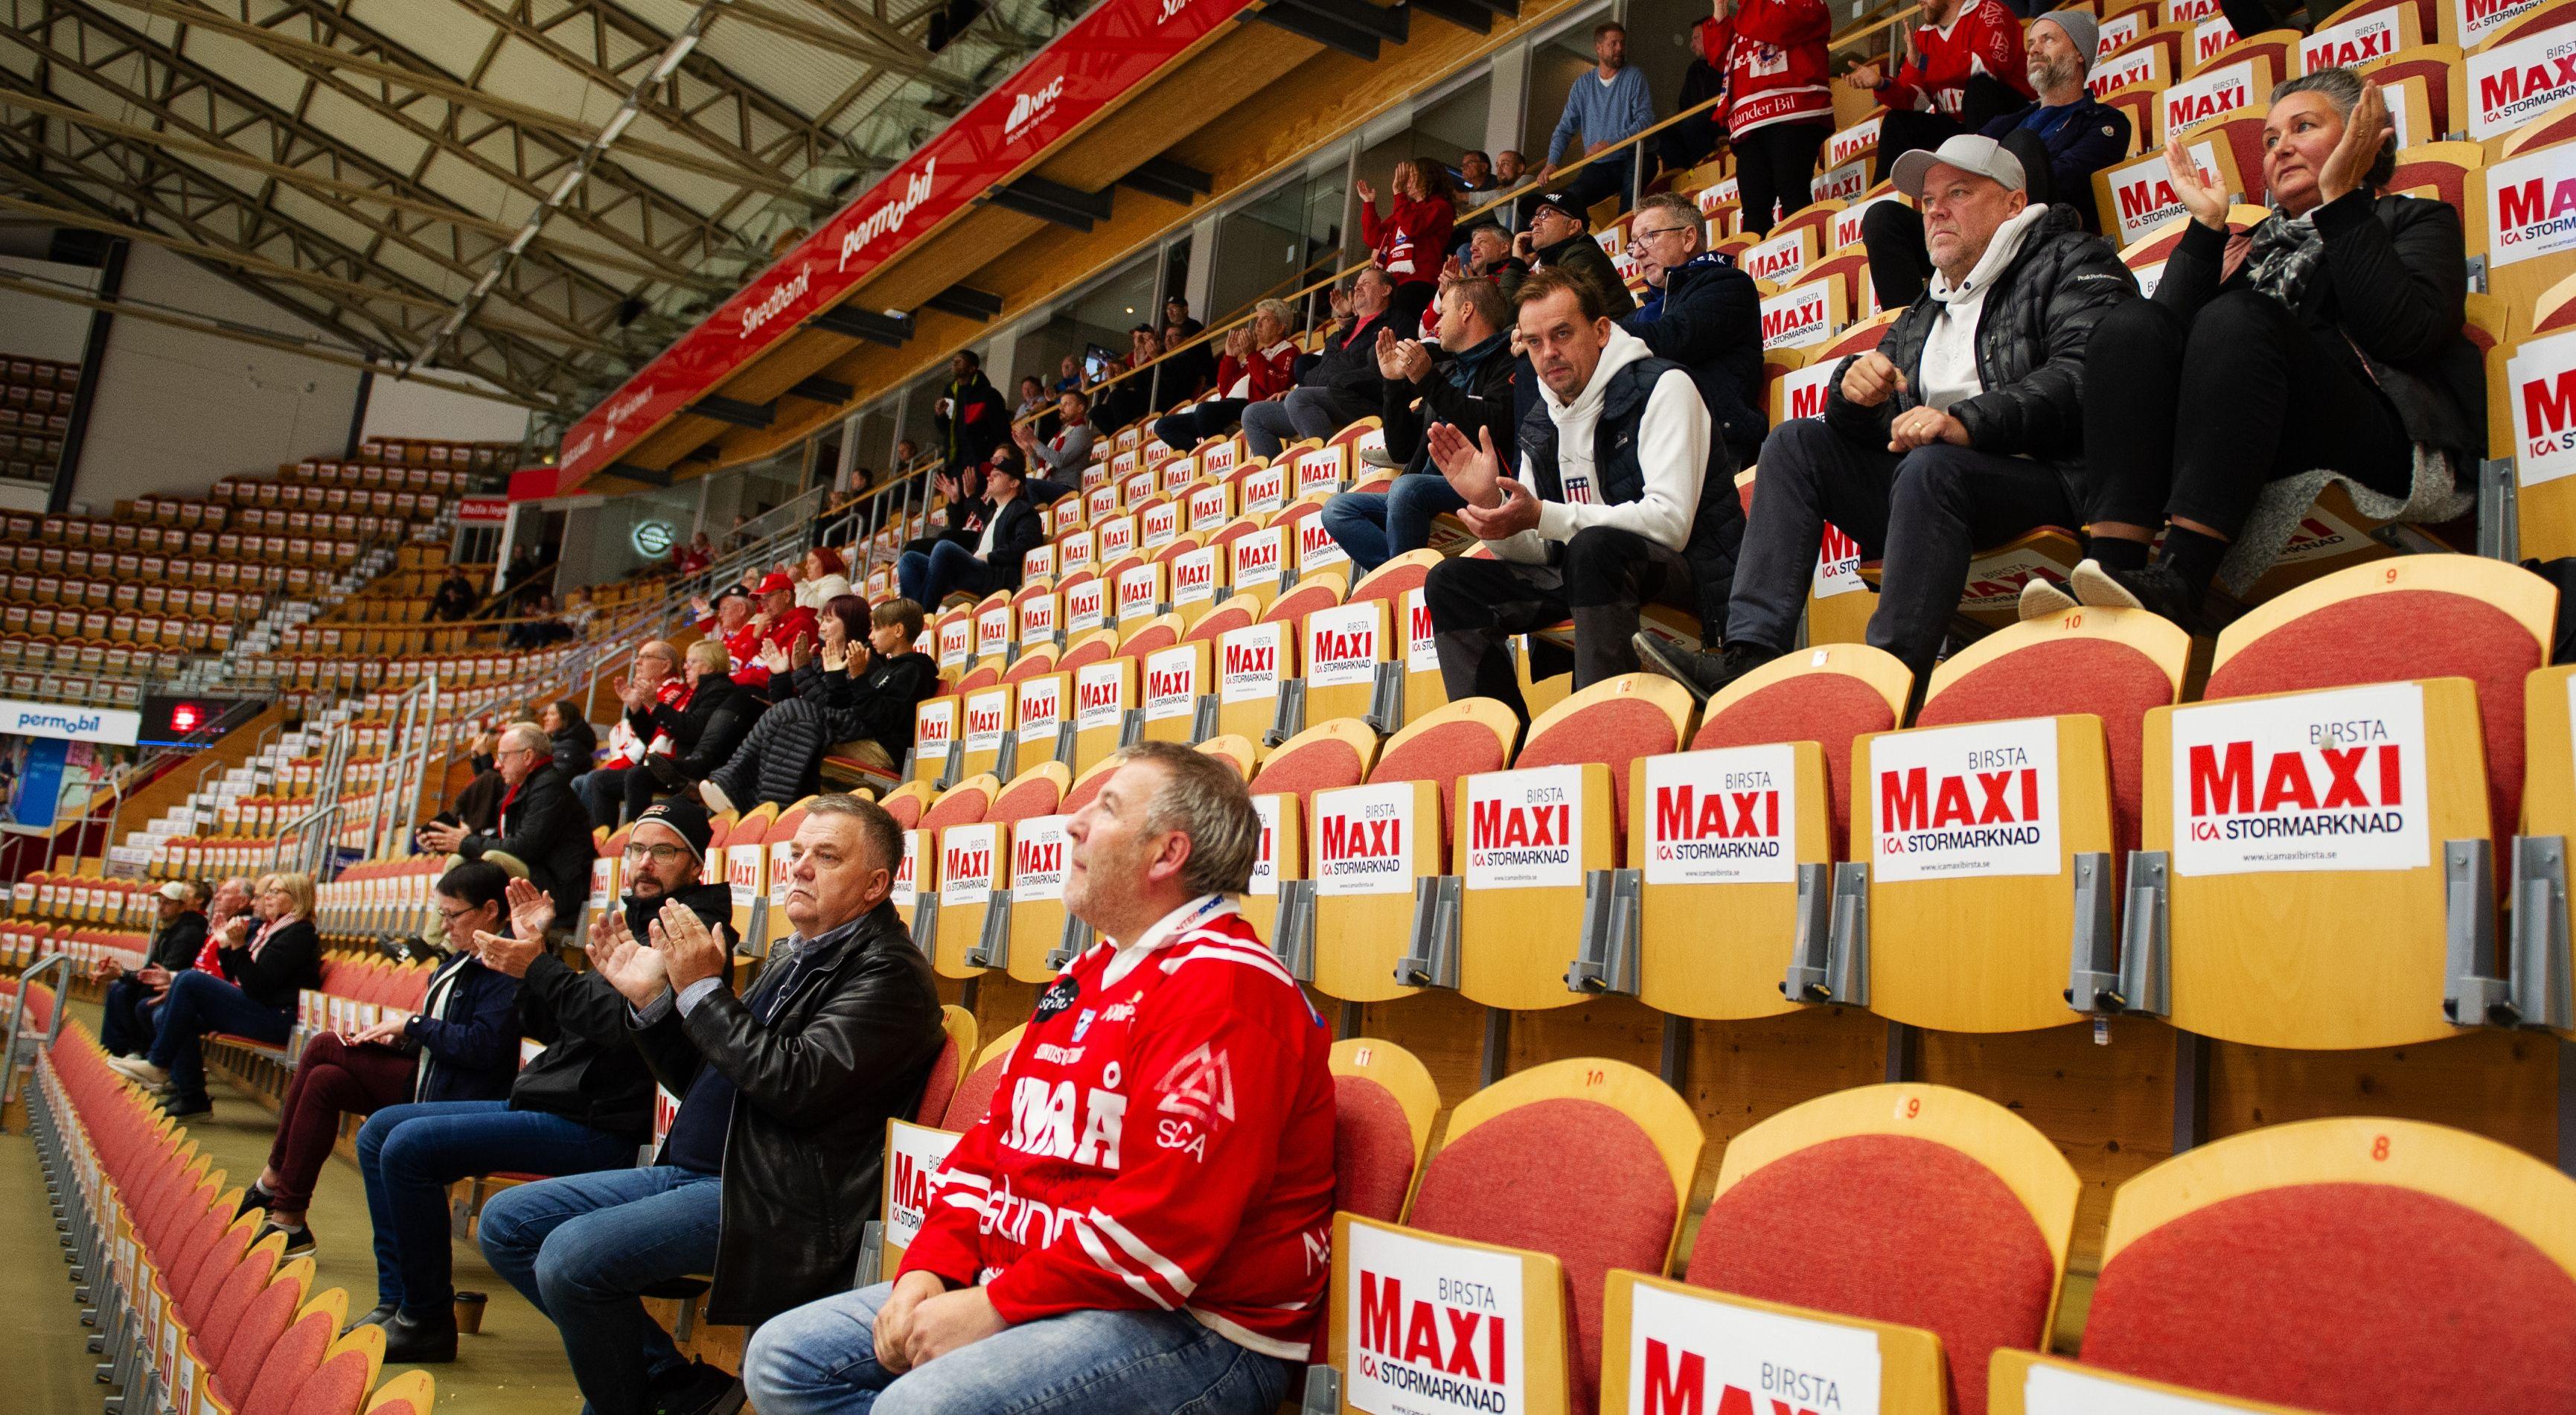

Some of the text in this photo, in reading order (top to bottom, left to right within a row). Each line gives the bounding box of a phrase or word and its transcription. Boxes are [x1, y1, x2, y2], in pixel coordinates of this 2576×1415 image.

[2354, 22, 2385, 38] BIRSTA
[2467, 21, 2481, 33] ICA
[2097, 30, 2132, 56] AXI
[2307, 30, 2392, 74] MAXI
[2123, 57, 2145, 71] BIRSTA
[2088, 64, 2149, 99] MAXI
[2212, 77, 2240, 92] BIRSTA
[2481, 53, 2576, 112] MAX
[1029, 75, 1064, 117] NHC
[1774, 95, 1795, 112] Bil
[2170, 86, 2245, 129] MAXI
[2484, 108, 2502, 124] ICA
[1834, 132, 1878, 162] MAXI
[1814, 175, 1861, 203] MAXI
[839, 156, 937, 273] permobil
[2499, 177, 2576, 231] MA
[2127, 220, 2141, 230] ICA
[1777, 240, 1796, 252] BIRSTA
[2502, 231, 2522, 247] ICA
[1748, 246, 1799, 280] MAXI
[740, 261, 811, 340] Swedbank
[1796, 293, 1820, 306] BIRSTA
[1762, 299, 1824, 342] MAXI
[1877, 316, 1887, 325] 10
[1773, 322, 1824, 347] STORMARKNAD
[1148, 446, 1170, 463] MAXI
[2531, 438, 2557, 458] ICA
[1114, 461, 1134, 476] MAXI
[1207, 452, 1233, 473] MAXI
[1301, 461, 1337, 485] MAXI
[1084, 473, 1103, 489] MAXI
[1166, 469, 1190, 488] MAXI
[1129, 483, 1151, 500] MAXI
[1247, 478, 1280, 505] MAXI
[1058, 509, 1078, 526] MAXI
[1093, 498, 1114, 514] MAXI
[1194, 497, 1223, 522] MAXI
[1146, 514, 1173, 537] MAXI
[1104, 528, 1130, 550] MAXI
[1064, 543, 1089, 563] MAXI
[1239, 543, 1277, 572] MAXI
[1026, 558, 1049, 575] MAXI
[1177, 563, 1210, 588] MAXI
[2386, 569, 2397, 584] 9
[1122, 581, 1153, 606] MAXI
[1070, 593, 1099, 619] MAXI
[1024, 607, 1050, 630] MAXI
[1347, 620, 1370, 632] BIRSTA
[2064, 615, 2082, 630] 10
[980, 622, 1006, 641] MAXI
[1253, 636, 1272, 647] BIRSTA
[942, 633, 965, 654] MAXI
[1315, 630, 1372, 663] MAXI
[1412, 642, 1421, 653] ICA
[1172, 661, 1189, 671] BIRSTA
[1226, 644, 1274, 674] MAXI
[1314, 659, 1371, 674] ICA STORMARKNAD
[1148, 670, 1190, 700] MAXI
[1232, 671, 1273, 685] STORMARKNAD
[1080, 682, 1117, 711] MAXI
[1153, 694, 1189, 708] STORMARKNAD
[968, 709, 1000, 734] MAXI
[1022, 696, 1055, 724] MAXI
[19, 713, 101, 734] permobil
[919, 718, 947, 741] MAXI
[2310, 719, 2388, 745] BIRSTA
[1969, 747, 2027, 770] BIRSTA
[1725, 771, 1771, 790] BIRSTA
[2190, 740, 2403, 817] MAXI
[1527, 787, 1565, 804] BIRSTA
[1881, 766, 2039, 833] MAXI
[1366, 803, 1396, 820] BIRSTA
[1657, 785, 1780, 842] MAXI
[1473, 799, 1570, 850] MAXI
[2191, 812, 2404, 842] ICA STORMARKNAD
[971, 838, 988, 850] BIRSTA
[1041, 830, 1060, 843] BIRSTA
[1323, 815, 1401, 860] MAXI
[1883, 825, 2040, 855] ICA STORMARKNAD
[1016, 839, 1062, 875] MAXI
[1473, 849, 1570, 867] ICA STORMARKNAD
[1657, 840, 1780, 861] ICA STORMARKNAD
[729, 861, 755, 887] MAXI
[946, 847, 990, 882] MAXI
[1323, 859, 1401, 876] ICA STORMARKNAD
[951, 878, 988, 892] STORMARKNAD
[1022, 873, 1061, 887] STORMARKNAD
[1587, 1071, 1605, 1087] 10
[1907, 1098, 1920, 1119] 9
[1155, 1118, 1207, 1163] SCA
[2372, 1135, 2391, 1161] 8
[893, 1151, 928, 1215] MA
[892, 1206, 900, 1223] ICA
[1439, 1277, 1497, 1311] BIRSTA
[1360, 1269, 1506, 1393] MAXI
[1360, 1352, 1506, 1414] ICA STORMARKNAD
[1761, 1361, 1841, 1411] BIRSTA
